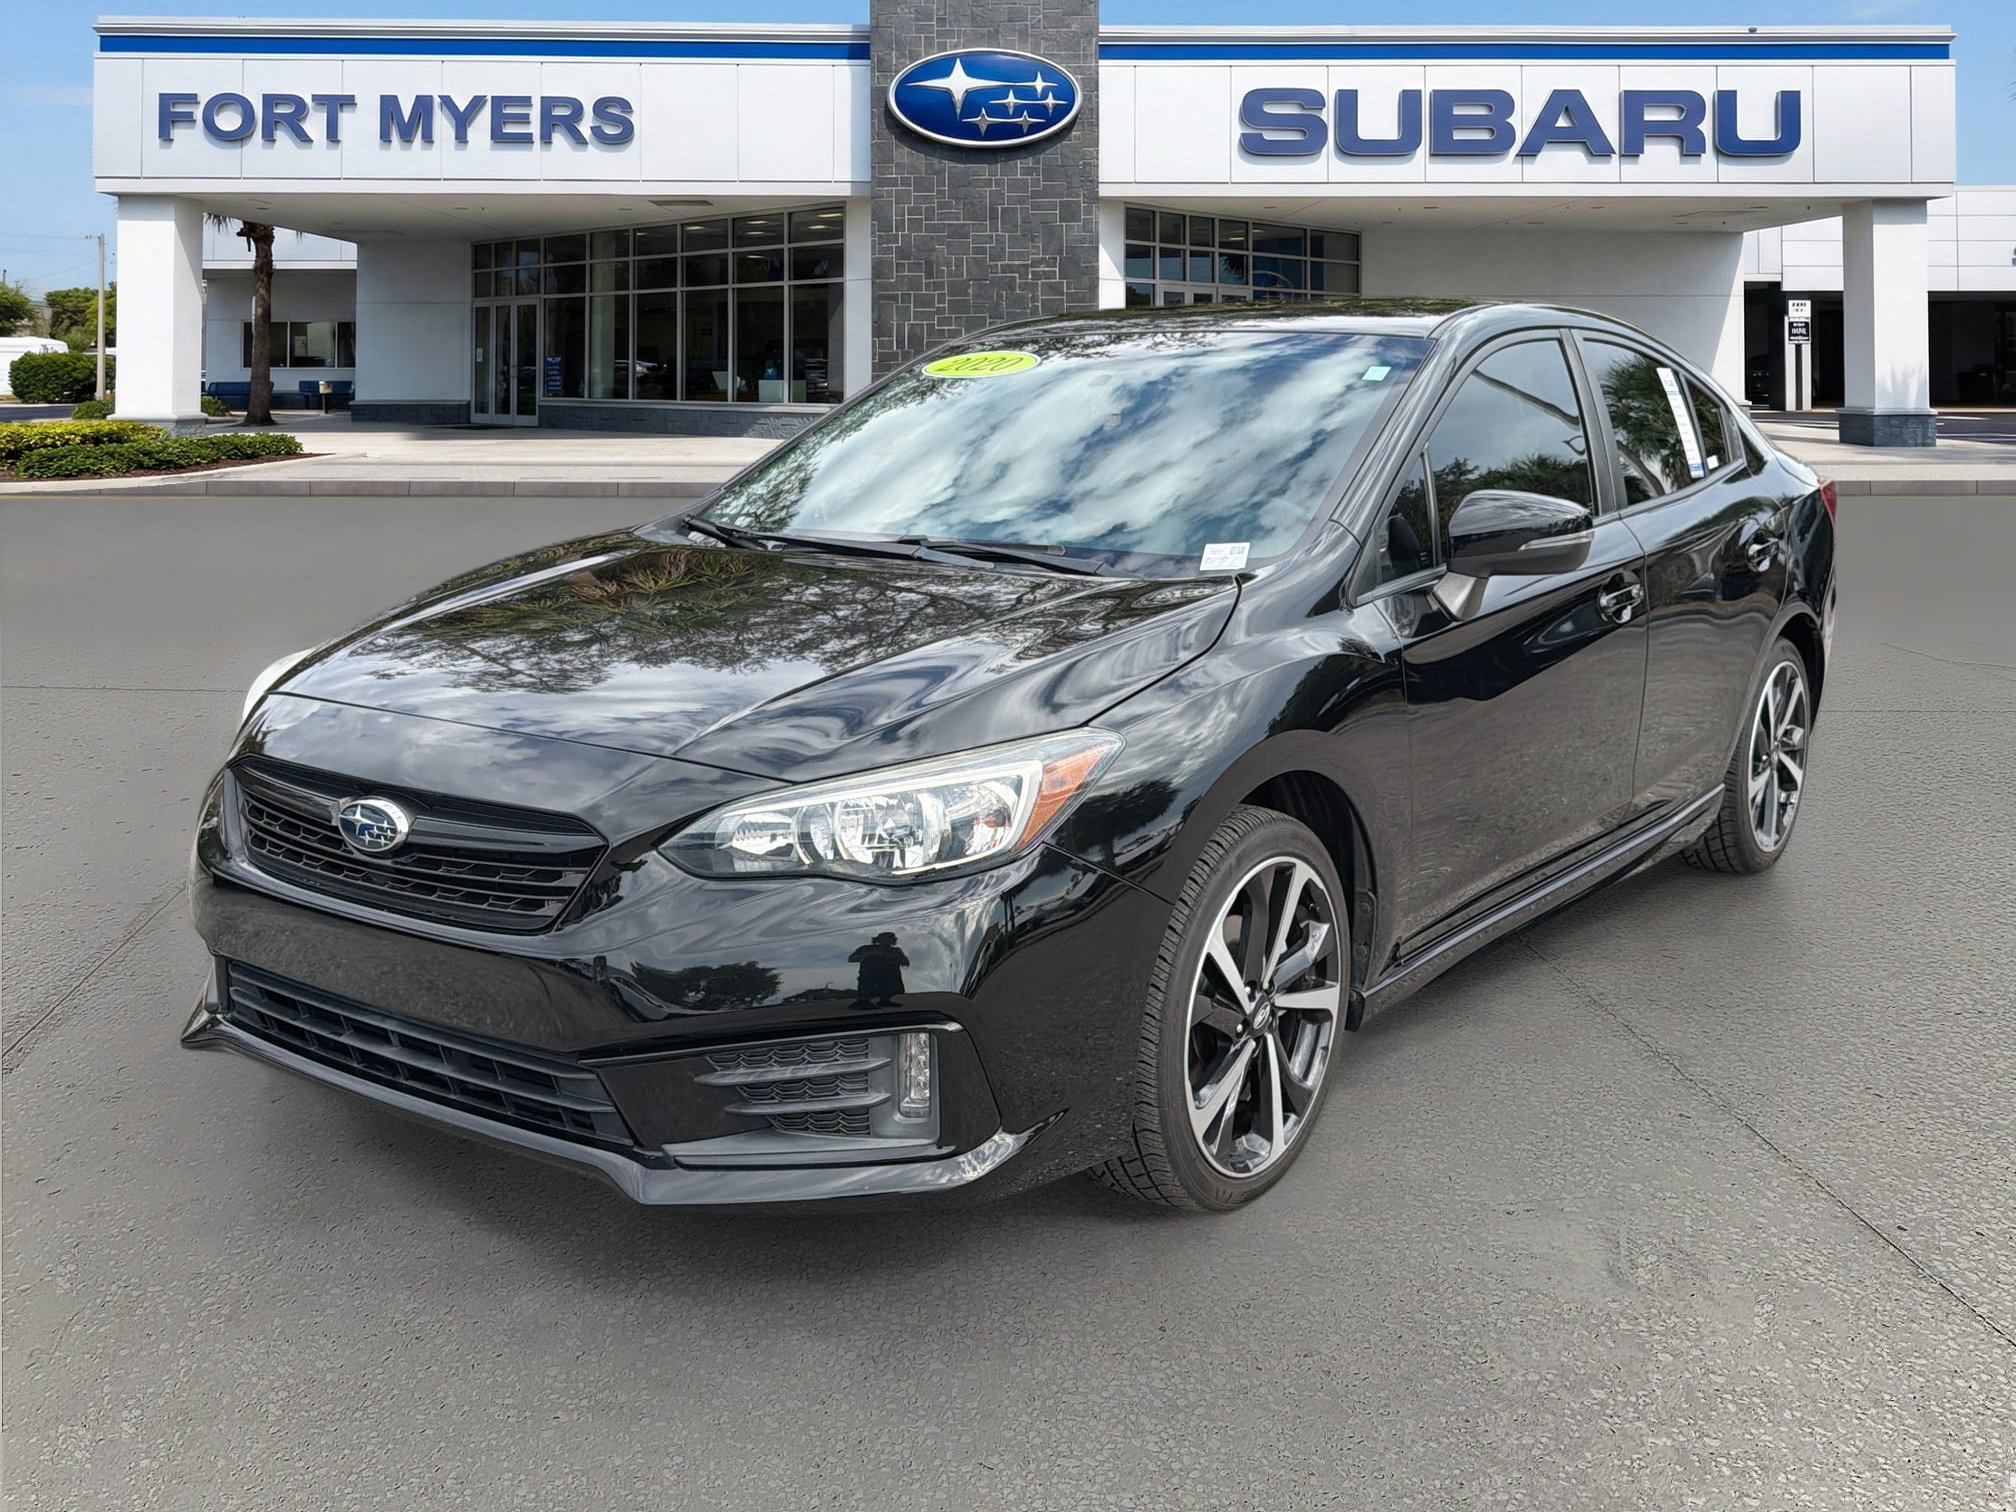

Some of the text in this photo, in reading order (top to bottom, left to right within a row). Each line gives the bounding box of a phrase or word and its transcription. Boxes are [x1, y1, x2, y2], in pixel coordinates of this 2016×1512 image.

[158, 93, 635, 145] FORT MYERS
[1240, 87, 1802, 157] SUBARU
[935, 356, 1025, 372] 2020
